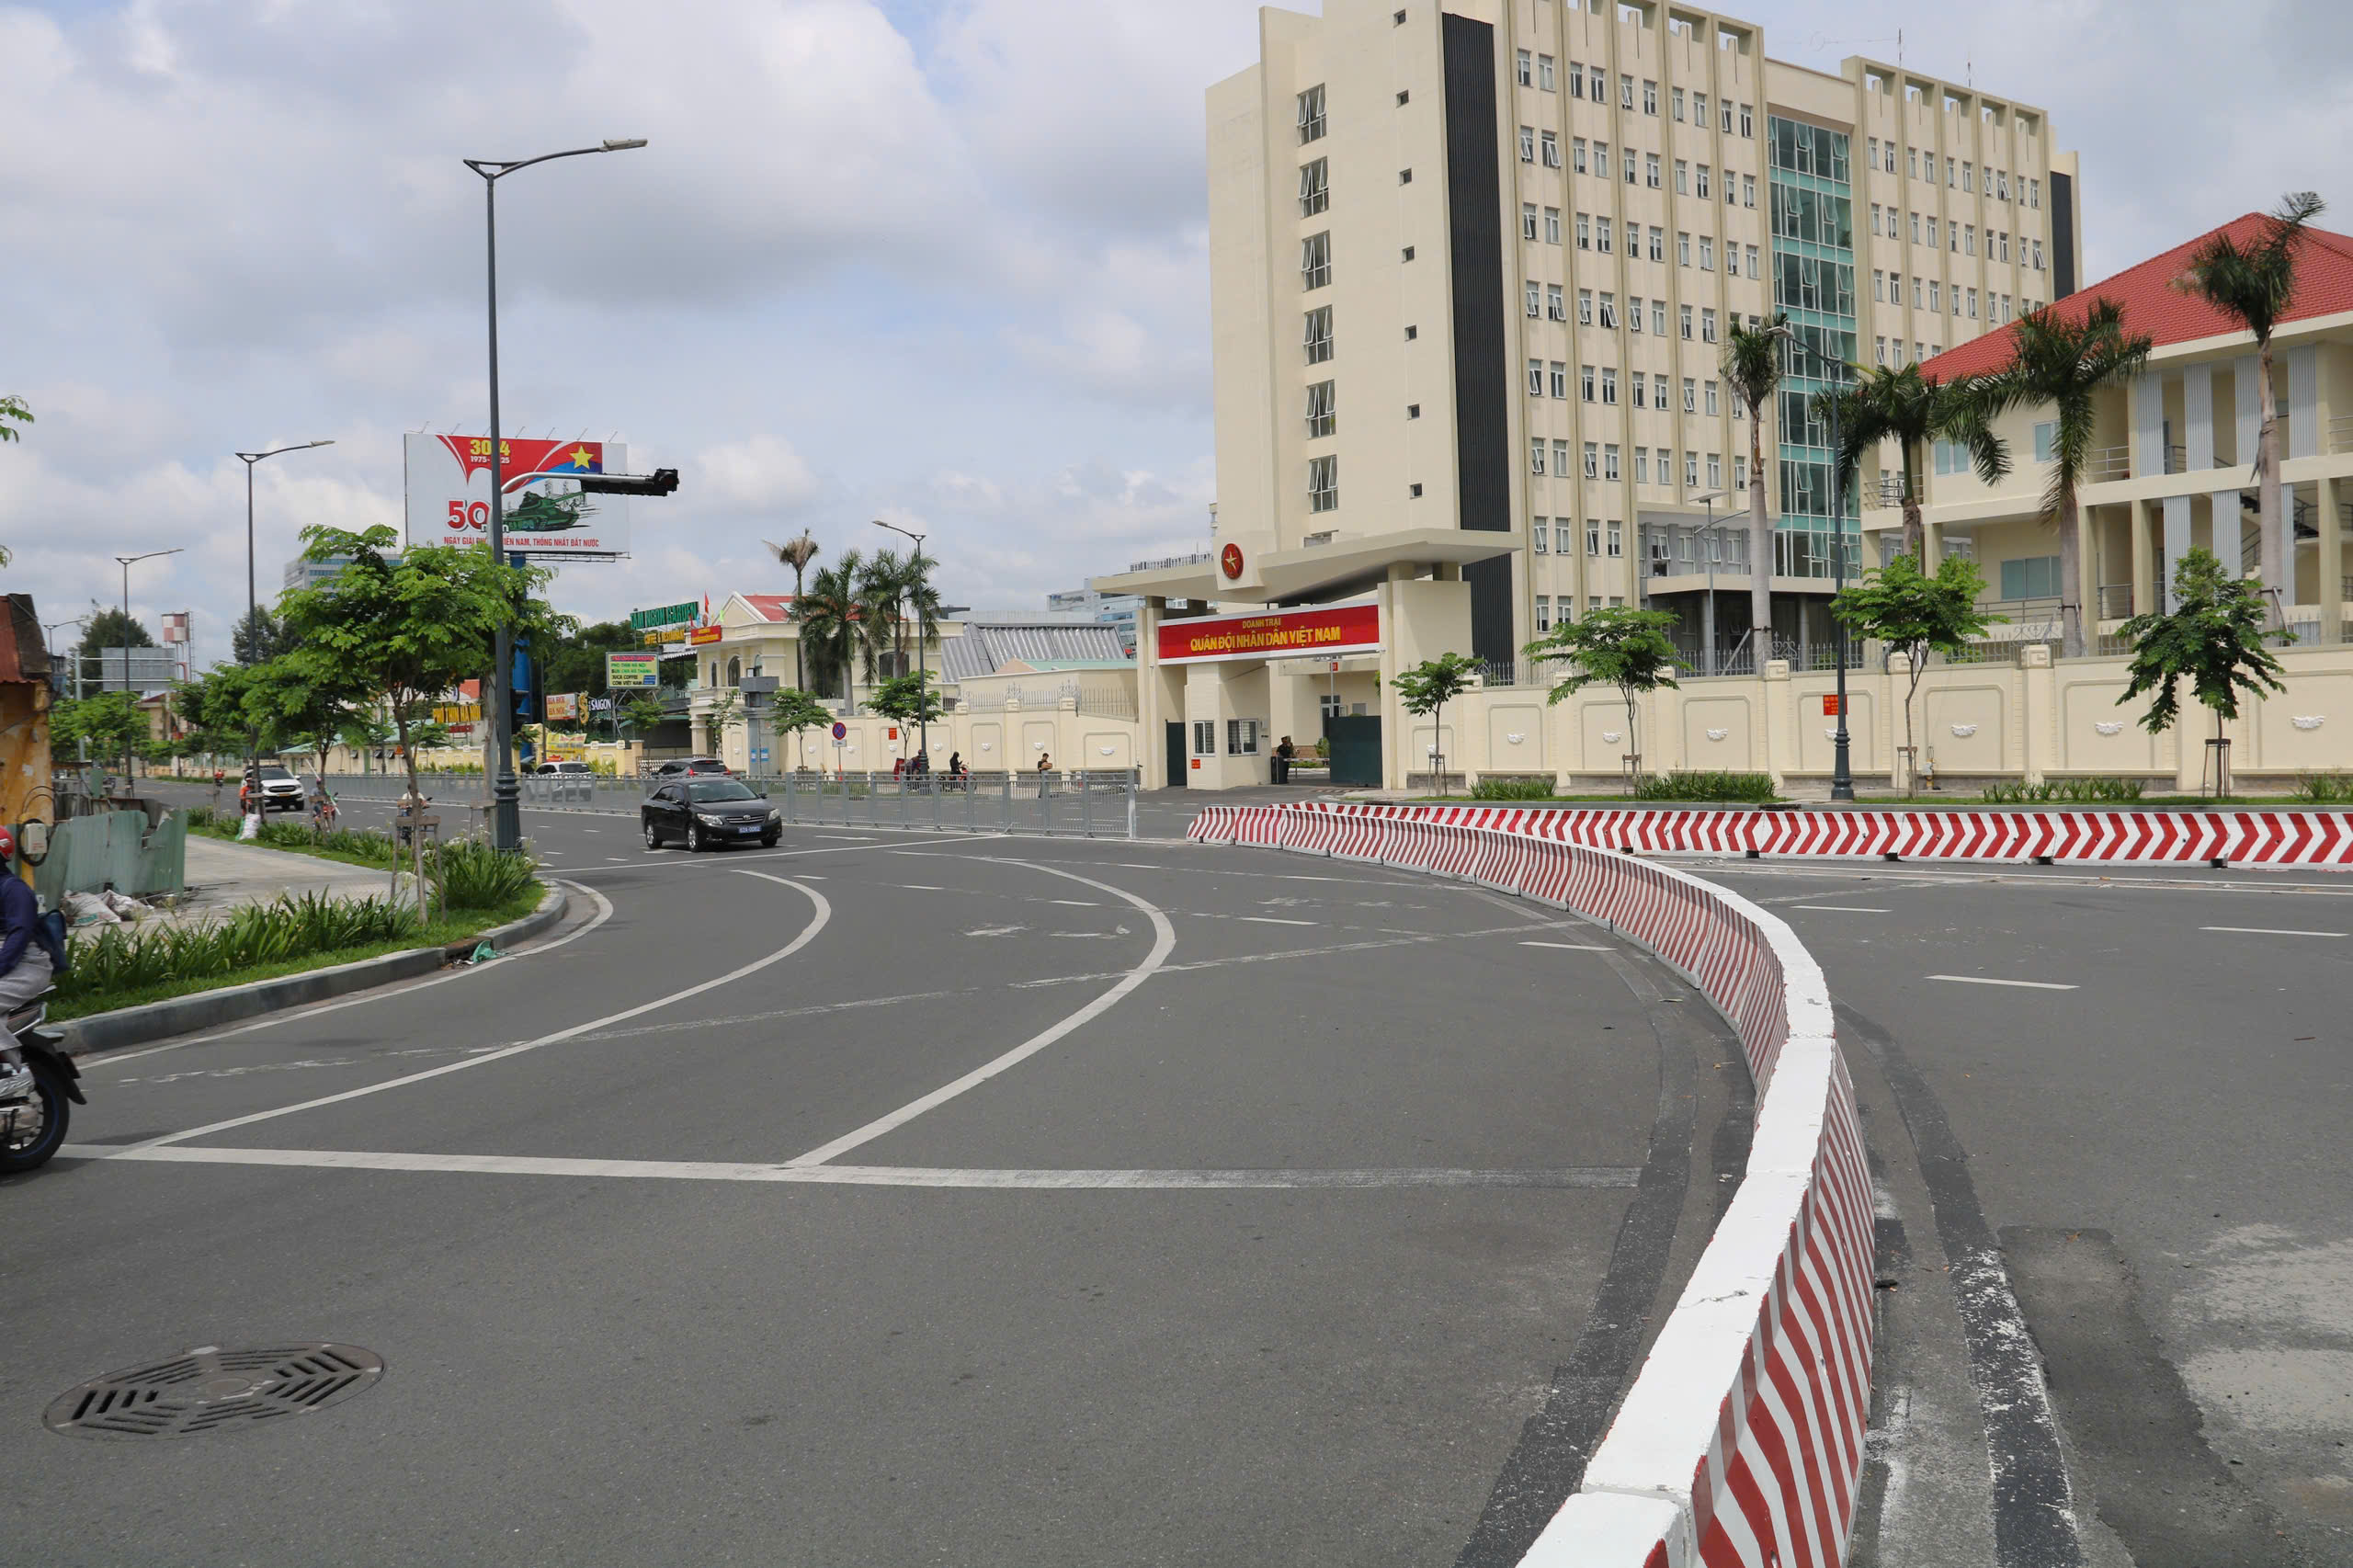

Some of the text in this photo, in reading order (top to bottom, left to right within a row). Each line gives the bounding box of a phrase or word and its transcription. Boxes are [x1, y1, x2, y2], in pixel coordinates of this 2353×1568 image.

[448, 500, 491, 531] 50
[666, 601, 699, 625] GARDEN
[1242, 617, 1281, 629] DOANH TRẠI
[1190, 625, 1341, 652] QUÂN ĐỘI NHÂN DÂN VIỆT NAM
[591, 699, 611, 710] SAIGON
